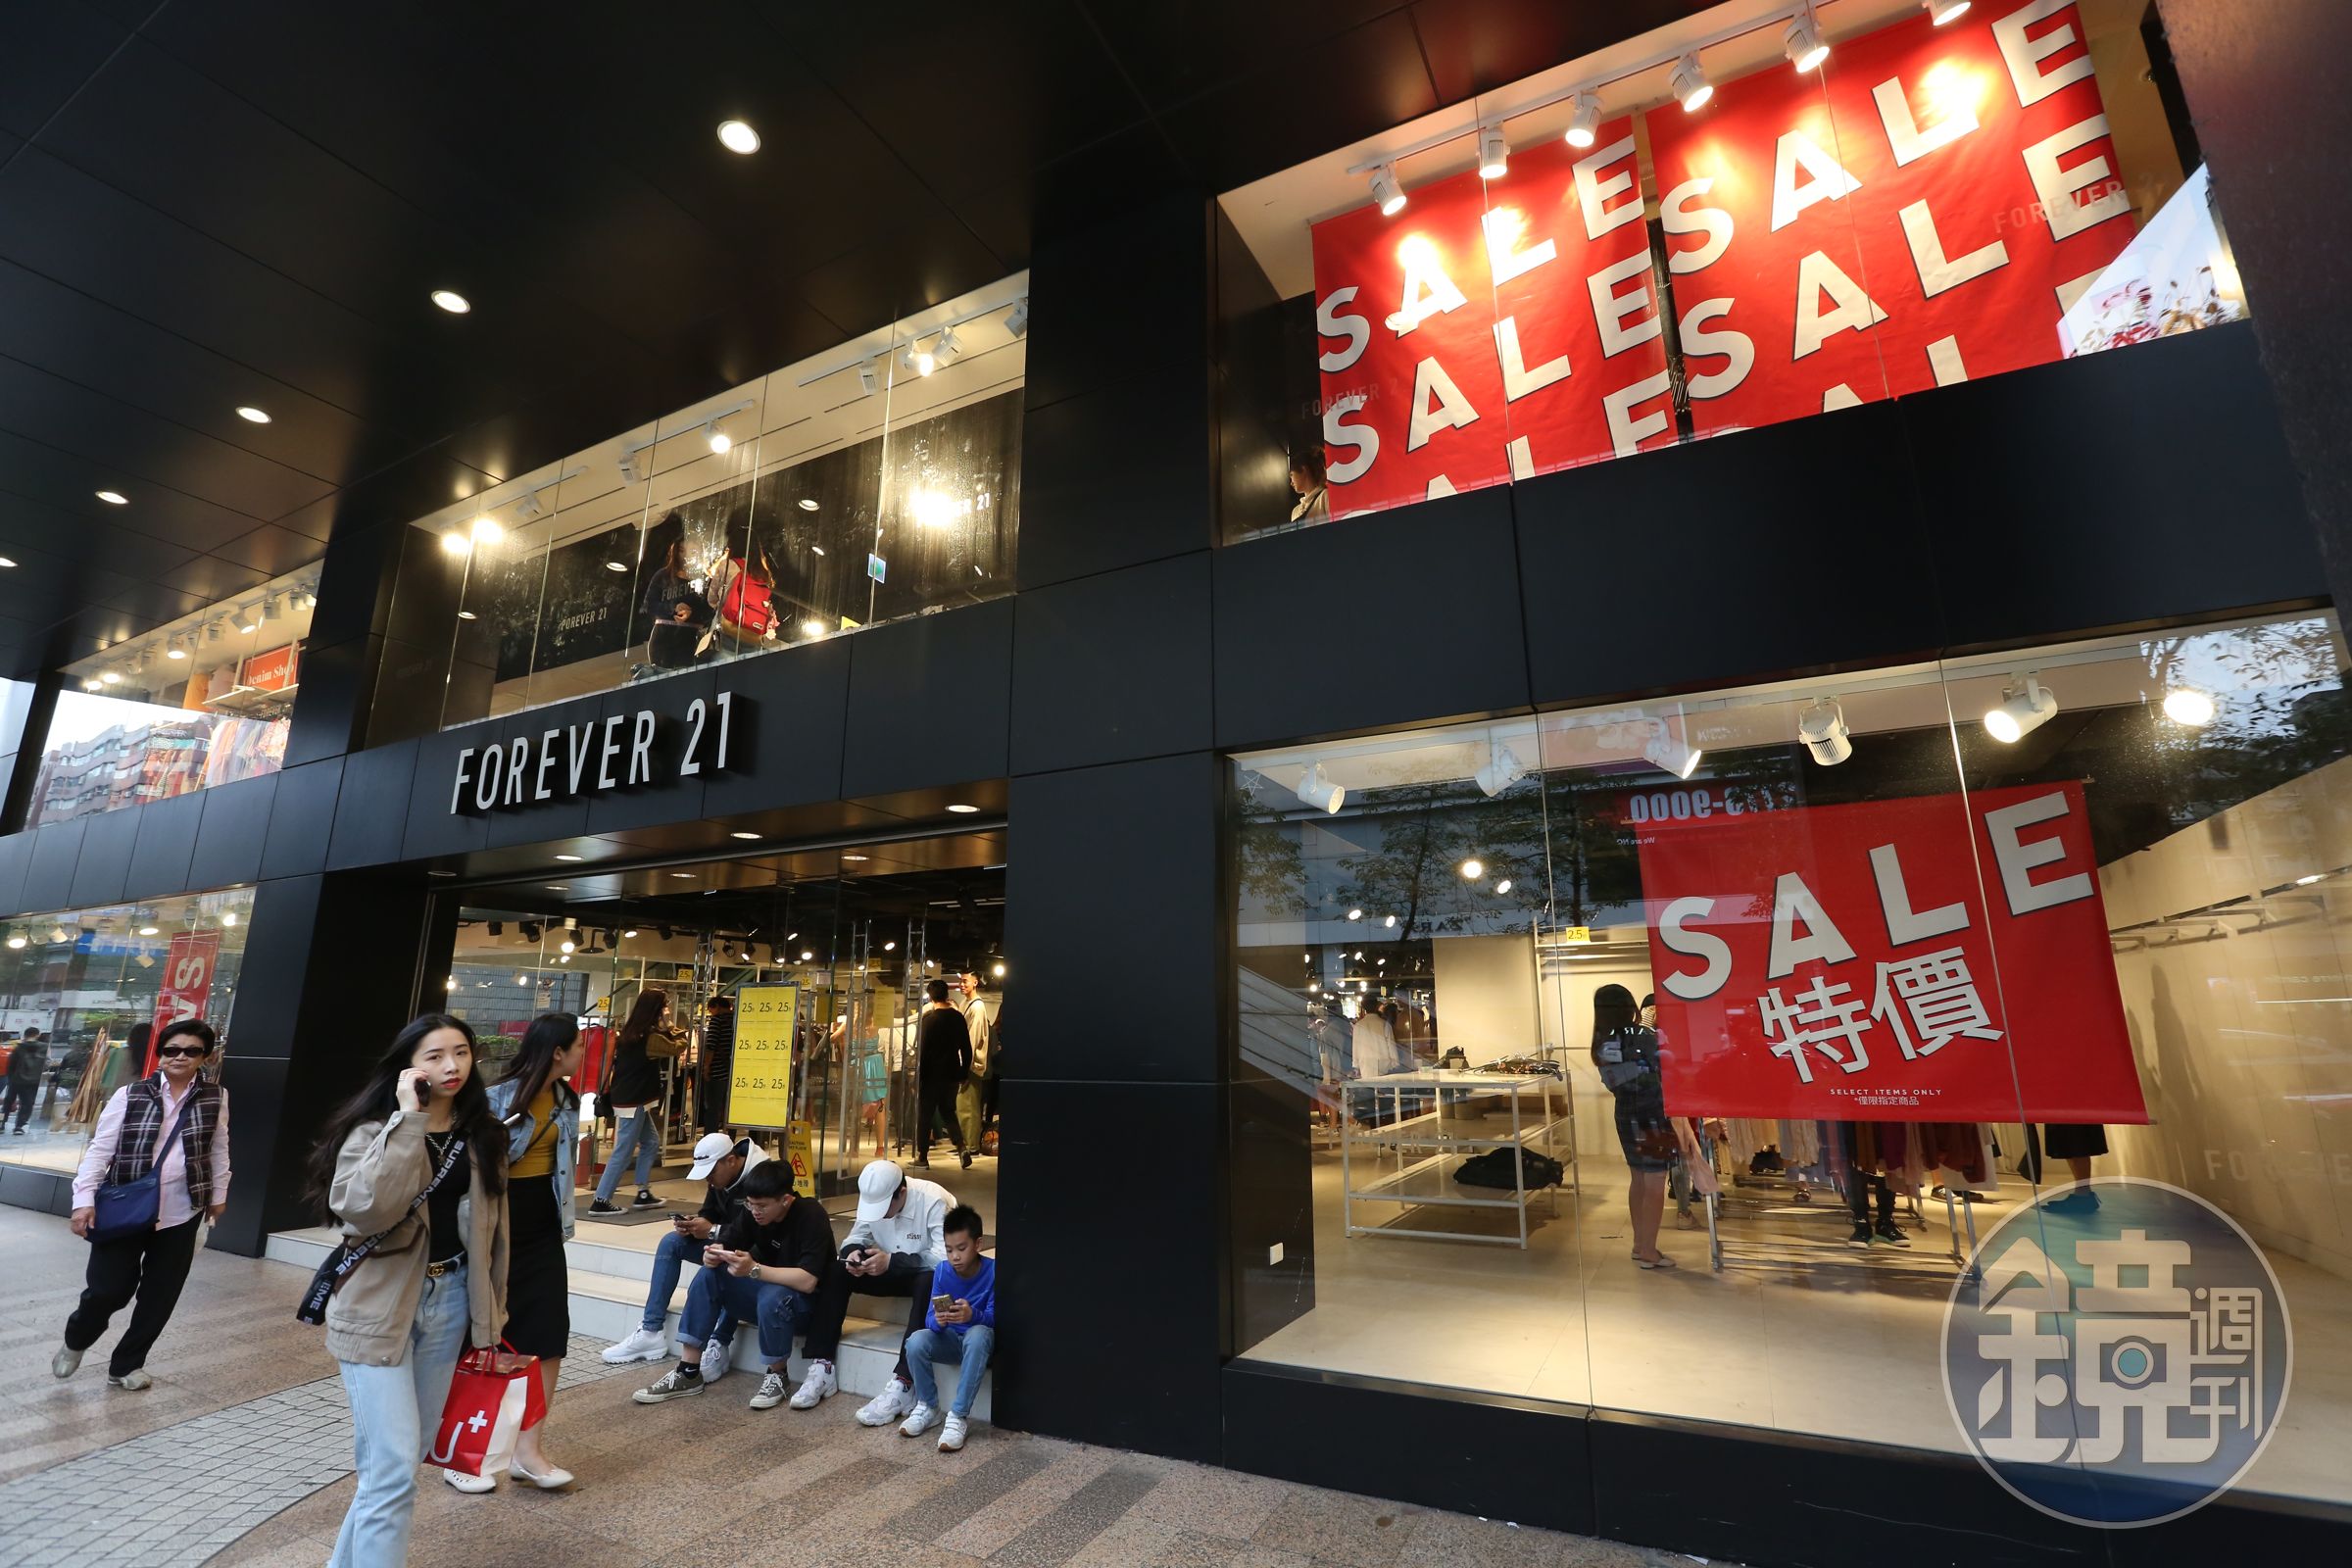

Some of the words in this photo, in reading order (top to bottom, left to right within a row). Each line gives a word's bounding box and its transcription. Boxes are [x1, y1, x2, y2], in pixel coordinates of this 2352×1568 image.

[1660, 0, 2094, 275] SALE
[1317, 133, 1645, 373] SALE
[1679, 114, 2132, 399] SALE
[1323, 253, 1664, 484] SALE
[450, 710, 656, 815] FOREVER
[680, 691, 732, 777] 21
[1658, 791, 2095, 1001] SALE
[1757, 946, 2005, 1084] 特價
[336, 1229, 391, 1275] PREME
[411, 1140, 466, 1208] SUPREME
